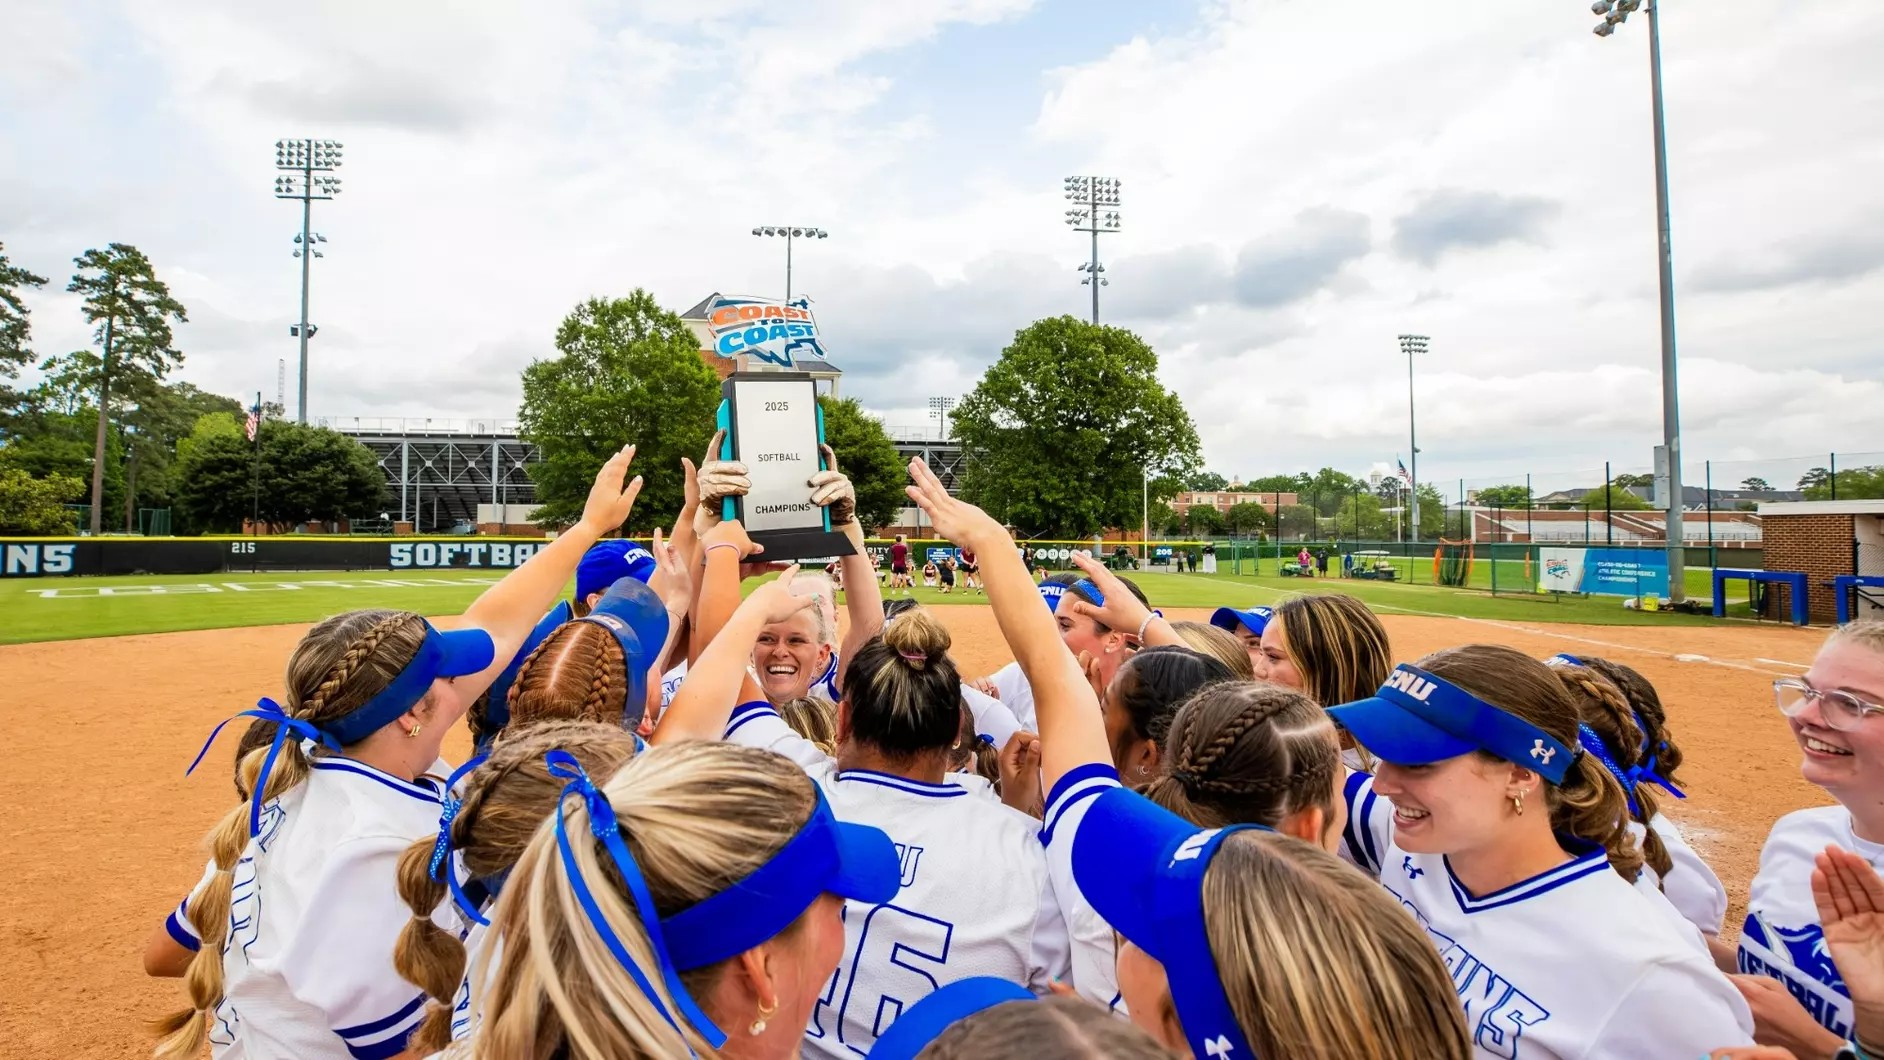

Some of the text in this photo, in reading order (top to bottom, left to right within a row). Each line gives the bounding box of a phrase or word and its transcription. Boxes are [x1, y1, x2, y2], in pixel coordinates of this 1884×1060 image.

[712, 306, 808, 325] COAST
[719, 325, 814, 353] COAST
[765, 402, 789, 411] 2025
[758, 453, 801, 462] SOFTBALL
[755, 503, 811, 514] CHAMPIONS
[231, 542, 256, 554] 215
[1156, 548, 1173, 556] 205
[389, 543, 548, 567] SOFTBA
[1384, 669, 1438, 701] CNU
